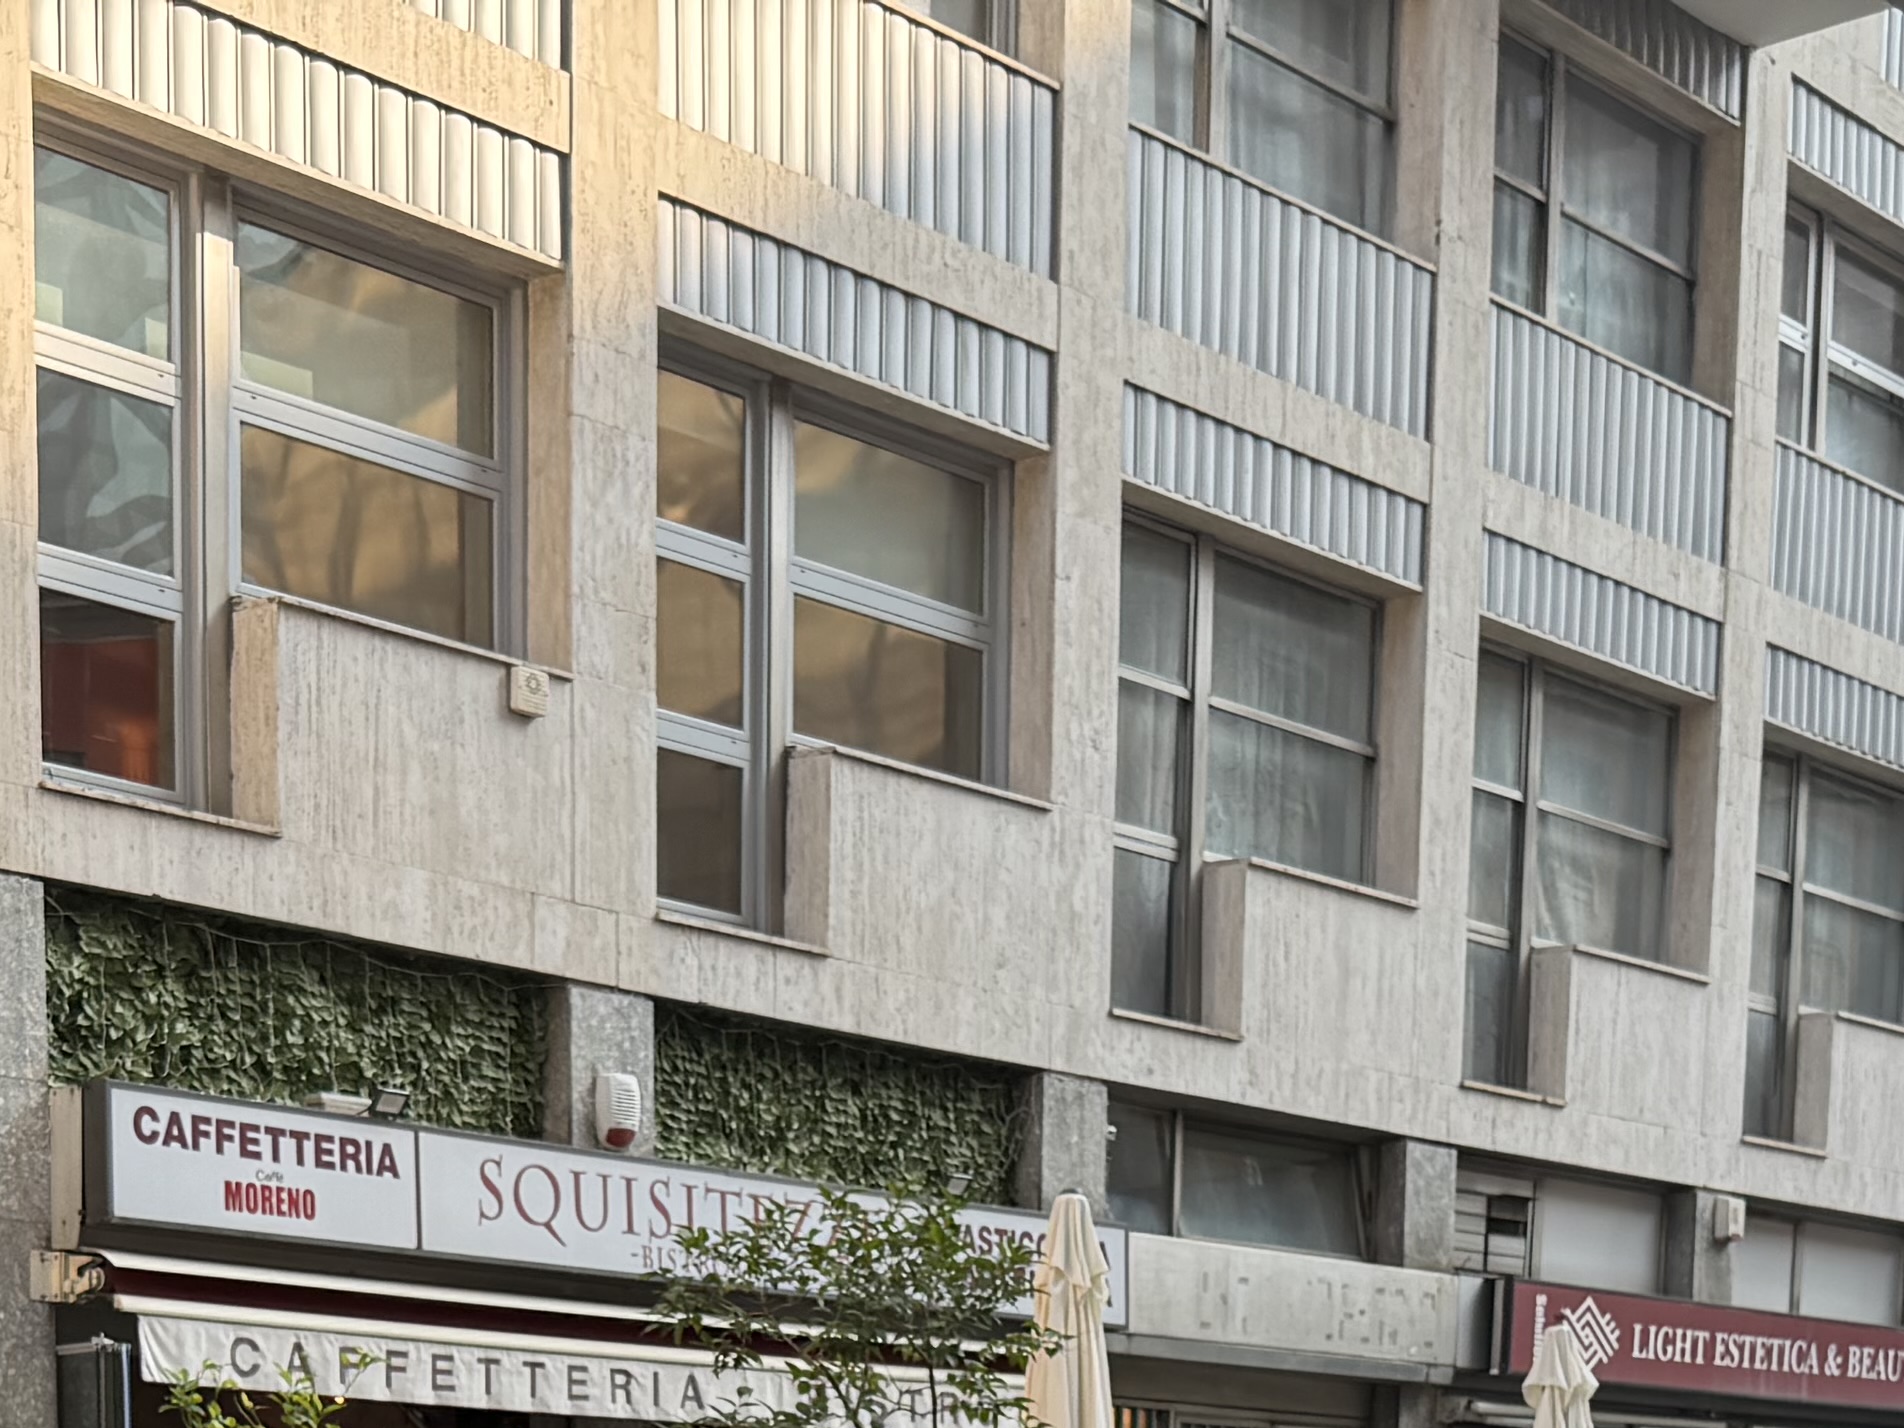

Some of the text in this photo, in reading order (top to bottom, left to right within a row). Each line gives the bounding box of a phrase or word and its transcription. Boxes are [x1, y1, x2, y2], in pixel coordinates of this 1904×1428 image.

[133, 1105, 400, 1179] CAFFETTERIA
[224, 1180, 317, 1221] MORENO
[1631, 1323, 1711, 1365] LIGHT
[1713, 1331, 1820, 1375] ESTETICA
[1824, 1342, 1843, 1377] &
